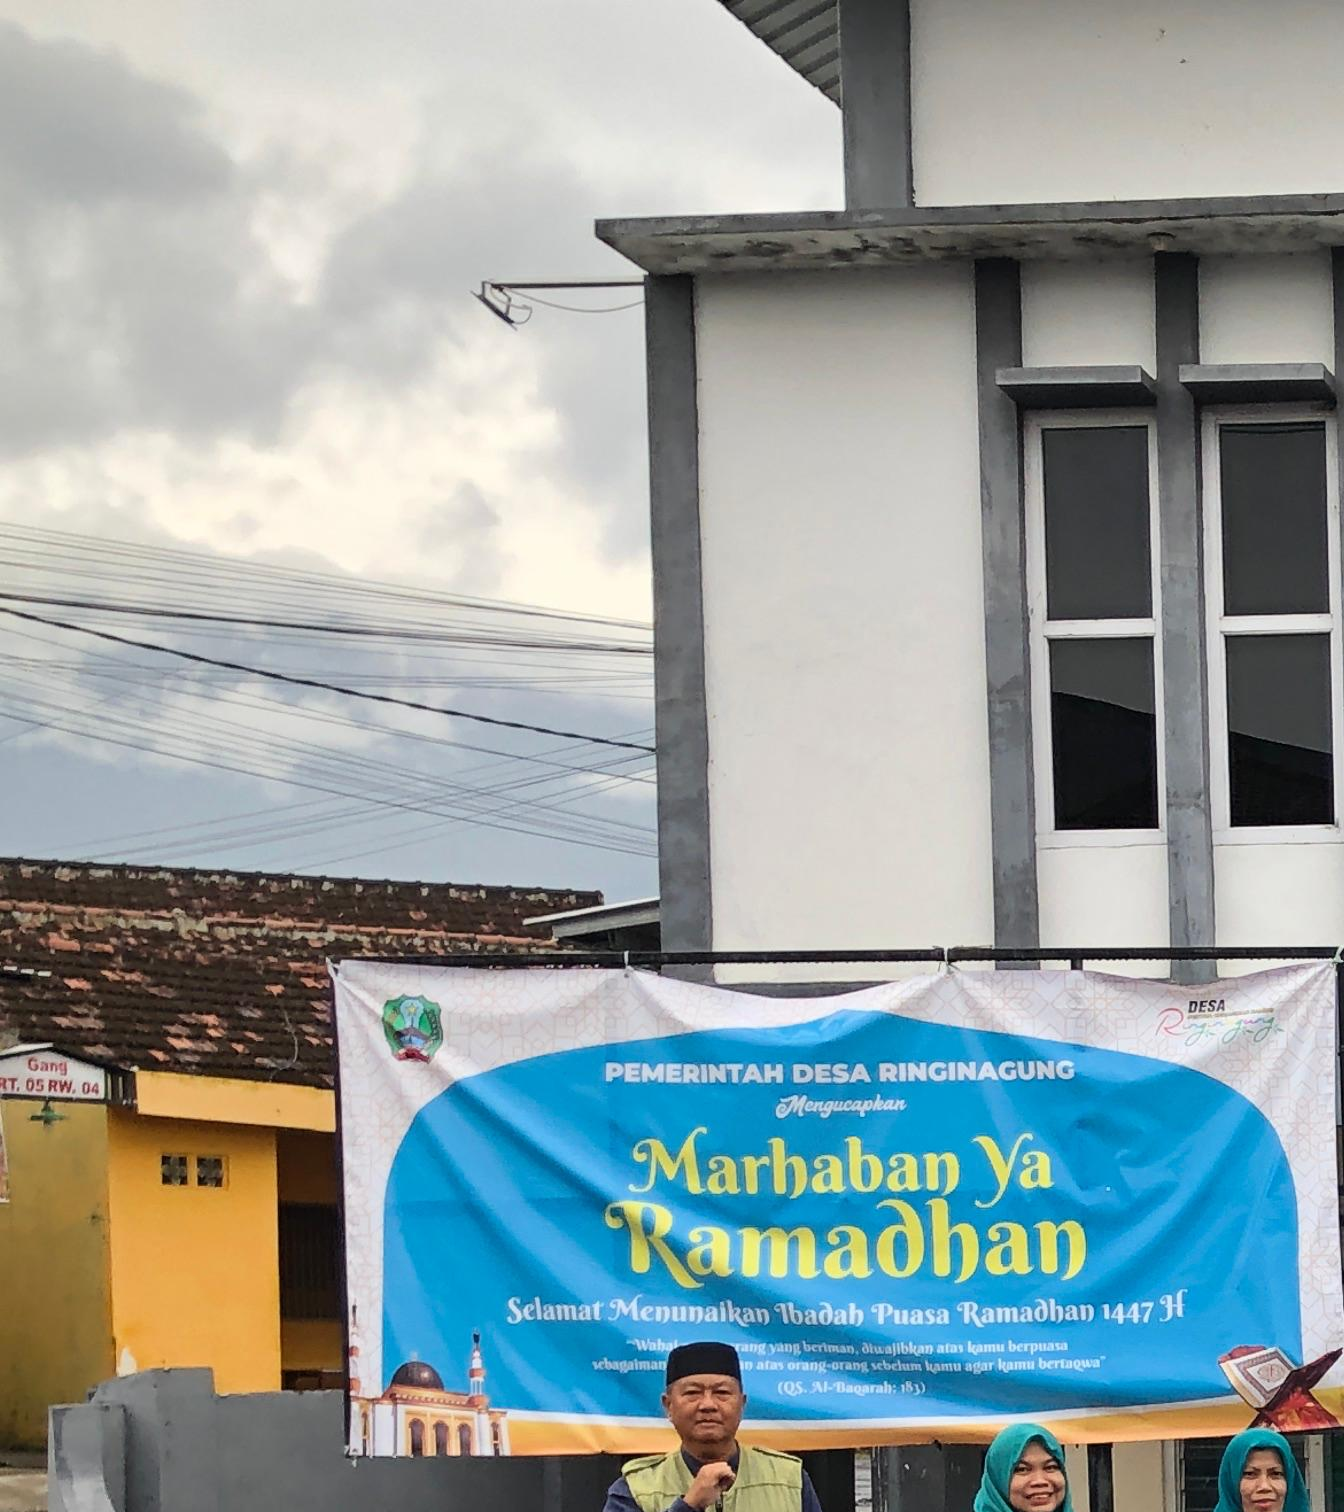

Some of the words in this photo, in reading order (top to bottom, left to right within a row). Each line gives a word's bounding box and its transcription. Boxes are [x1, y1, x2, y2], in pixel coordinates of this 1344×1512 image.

[1187, 999, 1226, 1014] DESA
[27, 1056, 68, 1076] Gang
[604, 1061, 784, 1083] PEMERINTAH
[793, 1062, 872, 1084] DESA
[880, 1060, 1075, 1082] RINGINAGUNG
[26, 1077, 45, 1092] 05
[48, 1080, 76, 1095] RW.
[82, 1082, 99, 1095] 04
[776, 1094, 908, 1119] Mengucapkan
[628, 1126, 960, 1199] Marhaban
[970, 1132, 1055, 1208] Ya
[604, 1198, 1088, 1289] Ramadhan
[507, 1297, 604, 1324] Selamat
[607, 1294, 770, 1327] Menunaikan
[774, 1302, 864, 1327] Ibadah
[871, 1302, 950, 1326] Puasa
[956, 1298, 1095, 1328] Ramadhan
[1101, 1301, 1155, 1325] 1447
[1159, 1289, 1189, 1323] H
[768, 1341, 801, 1356] yang
[861, 1340, 933, 1357] diwajibkan
[936, 1342, 964, 1354] atas
[967, 1340, 1005, 1356] kamu
[1008, 1339, 1069, 1355] berpuasa
[756, 1360, 785, 1371] atas
[787, 1359, 870, 1374] orang-orang
[871, 1358, 923, 1372] sebelum
[924, 1359, 962, 1375] kamu
[964, 1360, 994, 1375] agar
[997, 1357, 1035, 1374] kamu
[777, 1380, 808, 1395] (QS.
[900, 1380, 926, 1395] 183)
